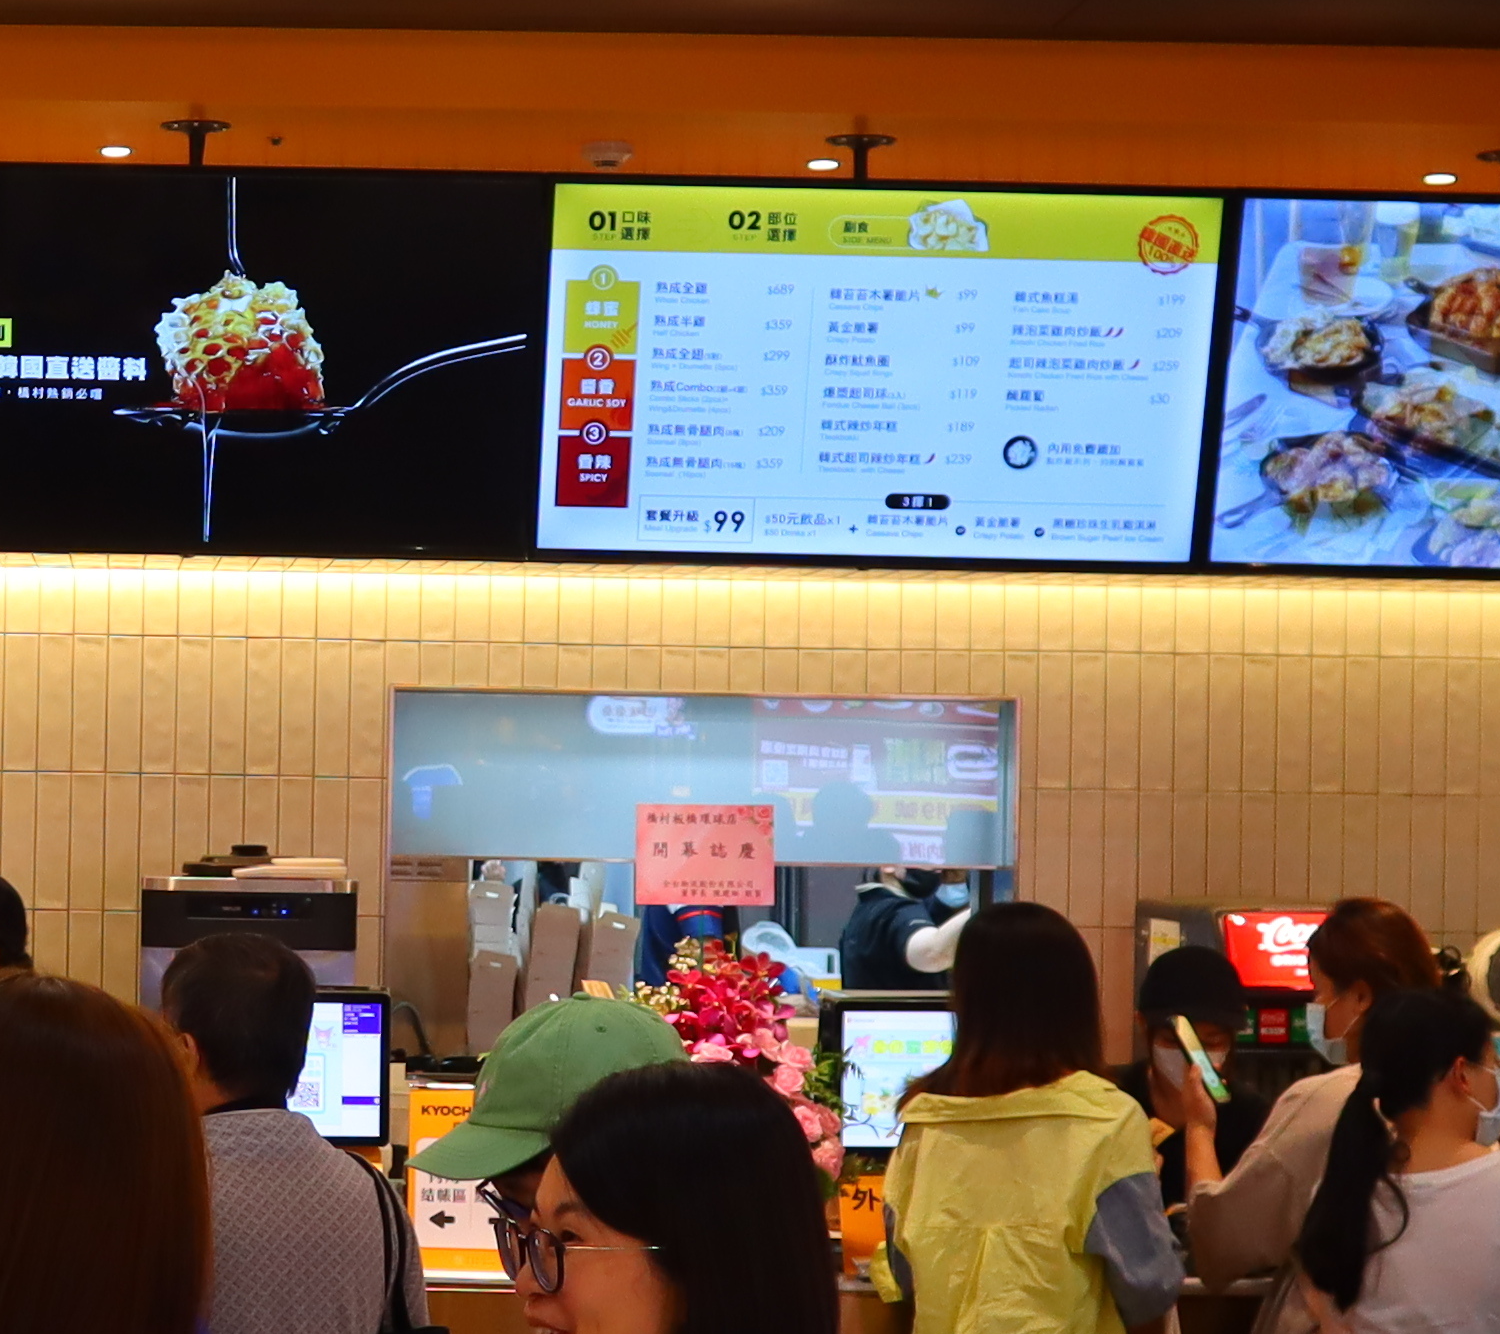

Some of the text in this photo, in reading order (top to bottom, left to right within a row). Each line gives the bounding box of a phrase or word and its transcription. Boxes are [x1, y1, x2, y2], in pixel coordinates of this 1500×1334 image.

[589, 211, 651, 231] 01 口味
[728, 210, 797, 231] 02 部位
[620, 227, 650, 241] 選擇
[766, 229, 797, 242] 選擇
[767, 284, 795, 296] $689
[958, 289, 978, 301] $99
[1158, 295, 1186, 306] $199
[584, 320, 619, 328] HONEY
[765, 319, 793, 331] $359
[955, 323, 976, 334] $99
[763, 350, 790, 362] $299
[952, 356, 980, 367] $109
[761, 384, 788, 396] $359
[950, 388, 978, 400] $119
[567, 398, 627, 408] GARLIC SOY
[758, 426, 785, 437] $209
[947, 422, 975, 433] $189
[756, 458, 784, 469] $359
[945, 453, 972, 465] $239
[579, 472, 608, 483] SPICY
[652, 841, 757, 860] 開幕誌慶
[421, 1105, 473, 1116] KYOCH
